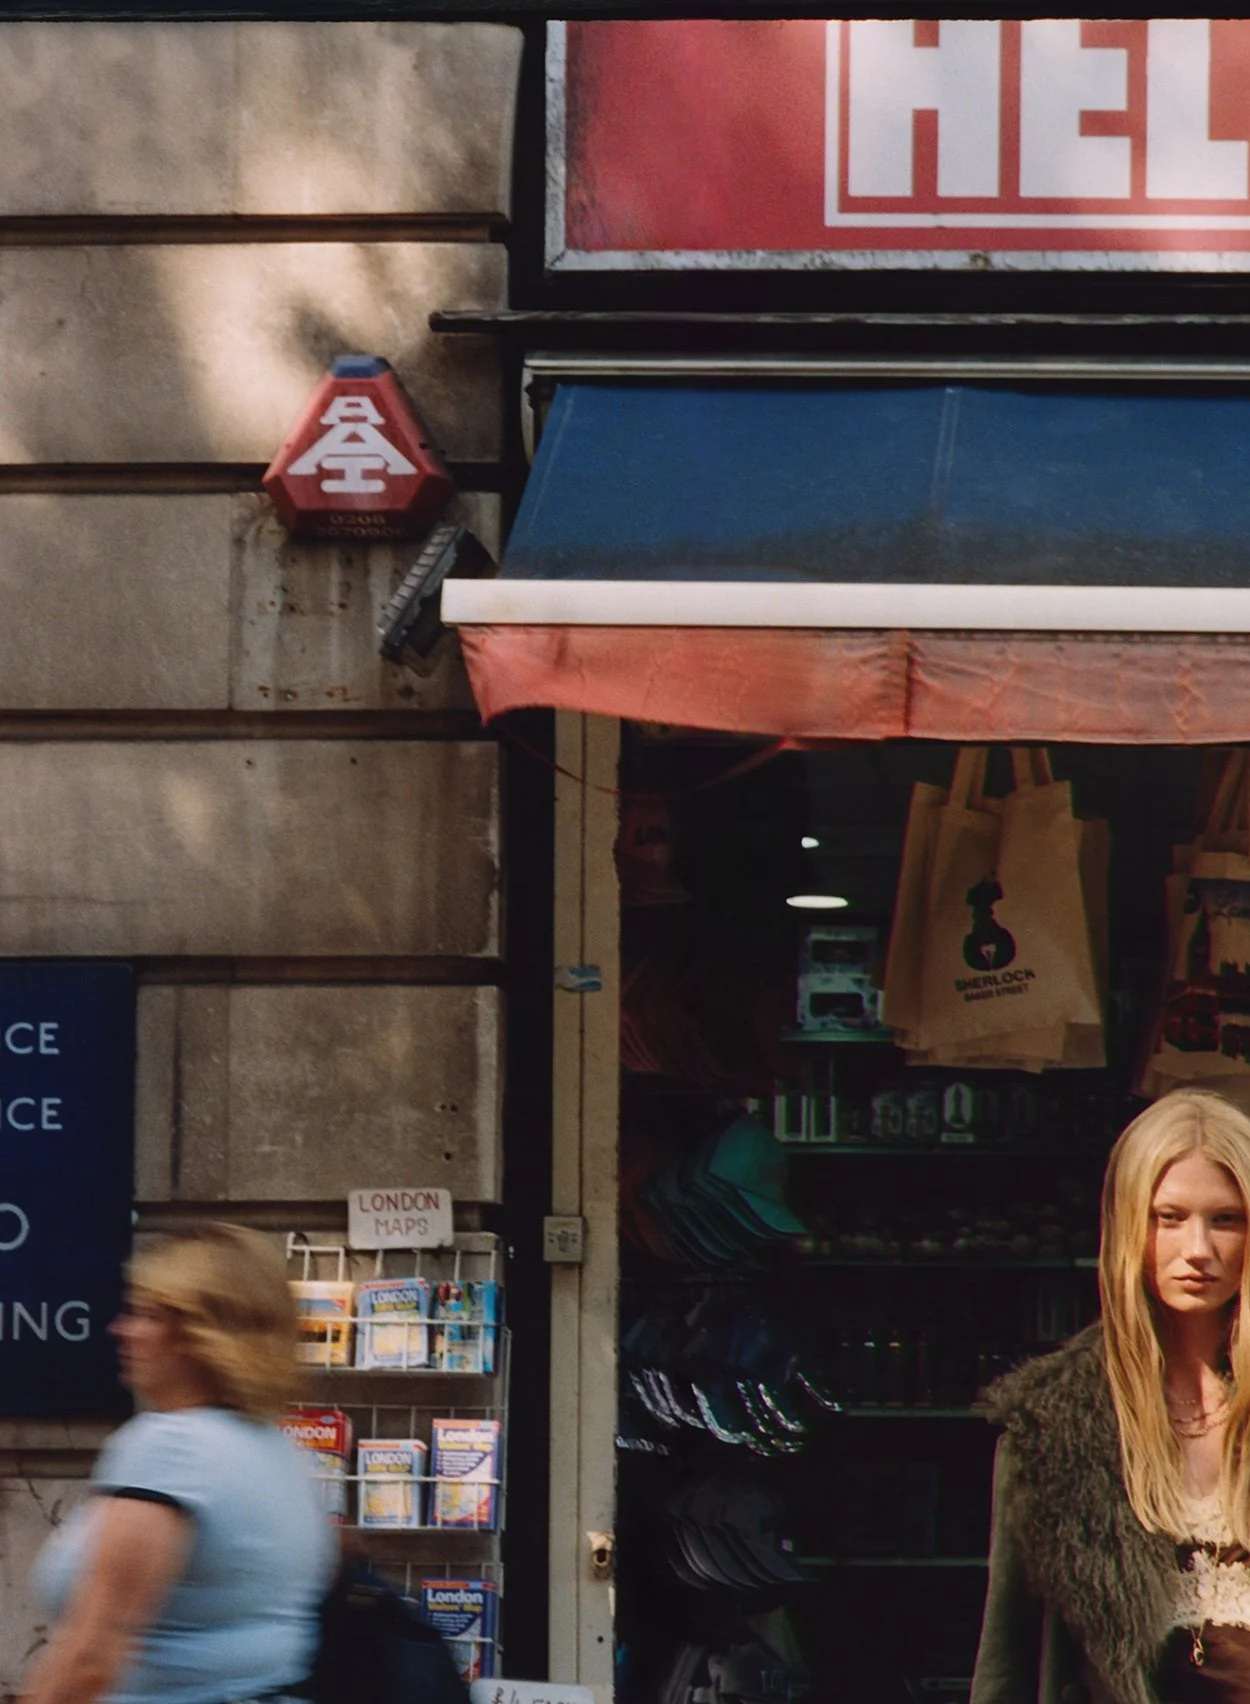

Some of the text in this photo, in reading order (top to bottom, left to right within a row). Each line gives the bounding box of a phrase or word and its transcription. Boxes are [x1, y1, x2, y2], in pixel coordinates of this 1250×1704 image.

[954, 968, 1036, 992] SHERLOCK
[358, 1192, 440, 1213] LONDON
[374, 1218, 430, 1237] MAPS
[371, 1288, 418, 1304] LONDON
[365, 1451, 412, 1466] LONDON
[427, 1588, 484, 1604] London
